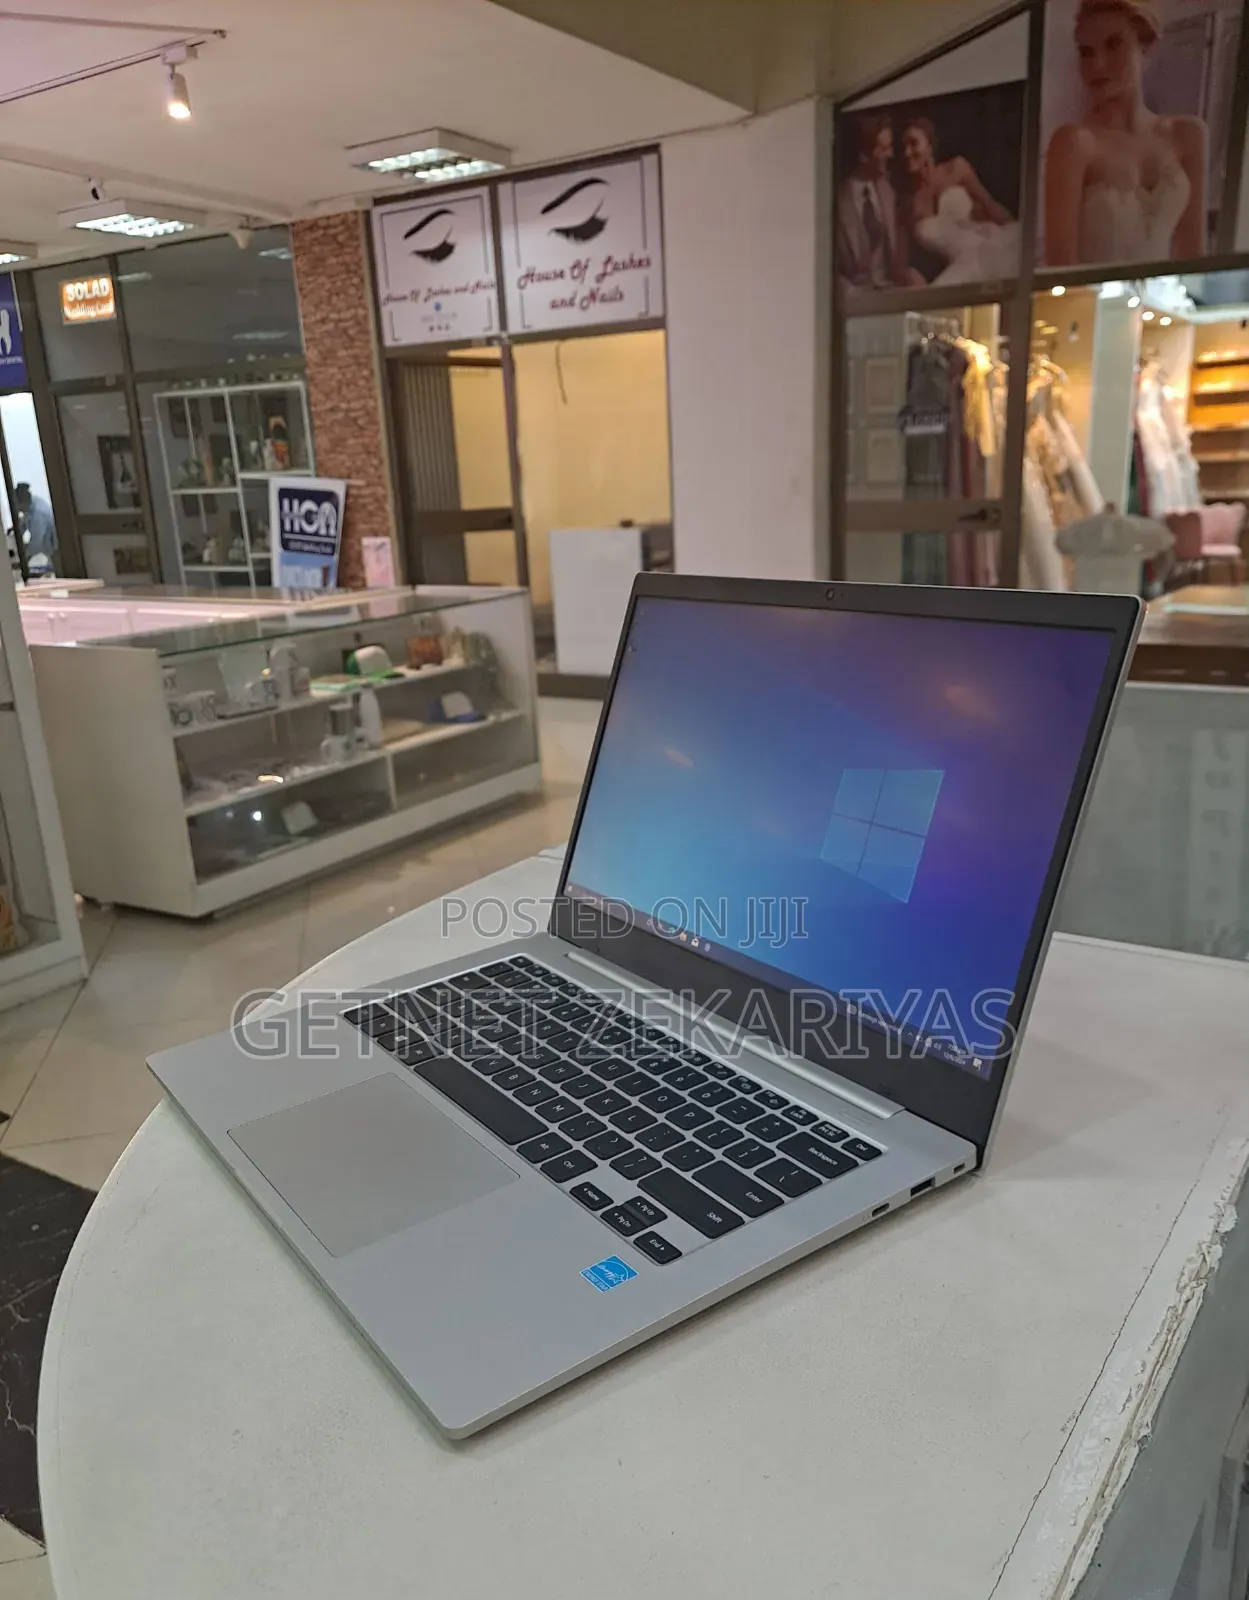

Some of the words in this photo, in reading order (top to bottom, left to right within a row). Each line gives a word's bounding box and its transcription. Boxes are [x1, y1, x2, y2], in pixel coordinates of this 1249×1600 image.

[517, 265, 565, 290] House
[569, 257, 591, 284] Of
[595, 252, 652, 284] Lashes
[550, 289, 578, 309] and
[579, 285, 625, 311] Nails
[808, 1147, 838, 1166] Backspace
[745, 1191, 763, 1203] Enter
[706, 1212, 723, 1223] Shift
[649, 1239, 661, 1249] End
